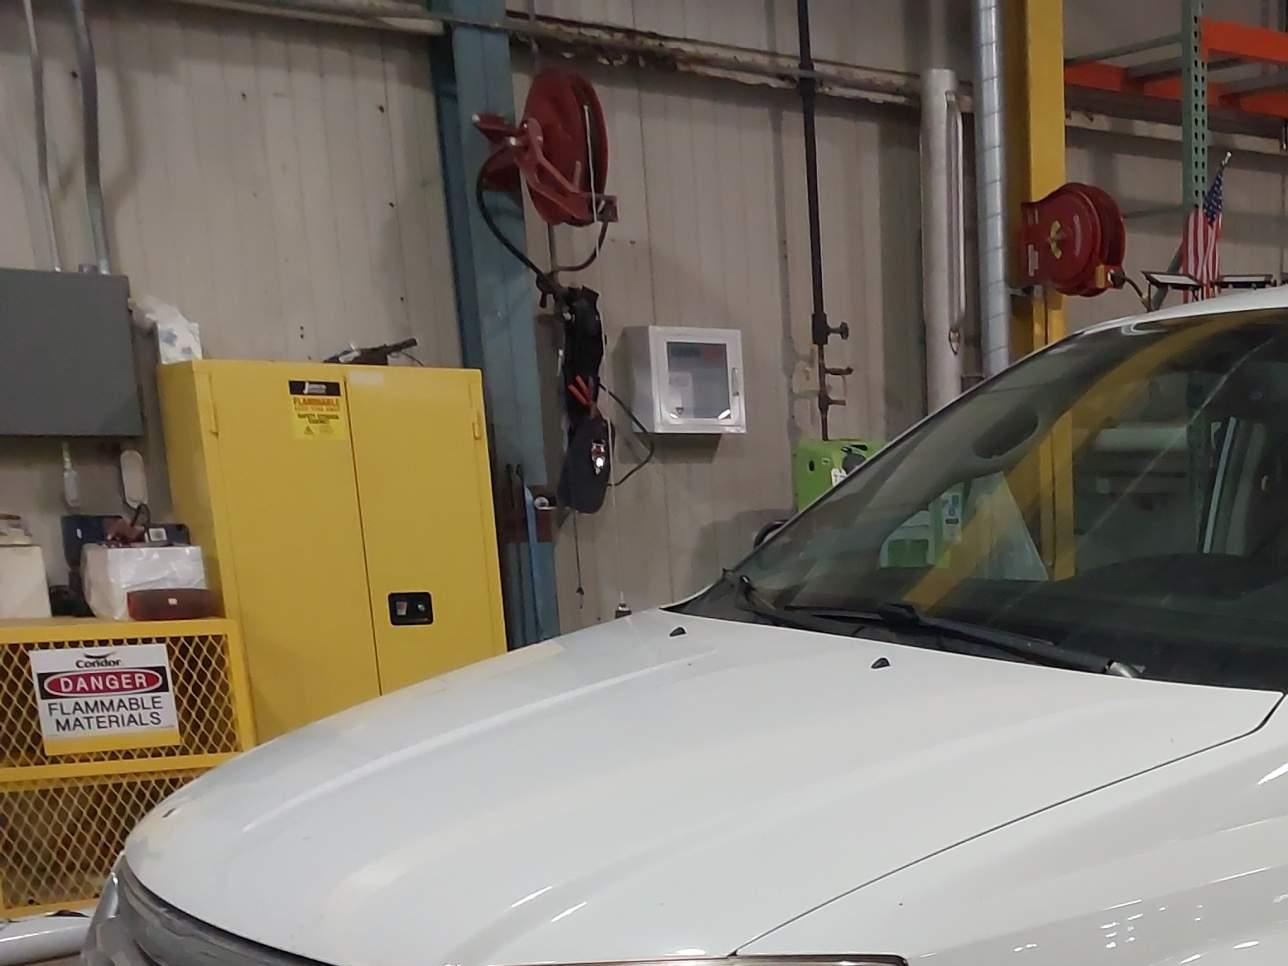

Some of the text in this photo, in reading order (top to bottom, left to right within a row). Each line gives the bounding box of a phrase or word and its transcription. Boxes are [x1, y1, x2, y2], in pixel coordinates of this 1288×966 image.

[75, 658, 121, 668] Condor
[60, 673, 148, 692] DANGER
[48, 696, 163, 716] FLAMMABLE
[56, 711, 162, 732] MATERIALS
